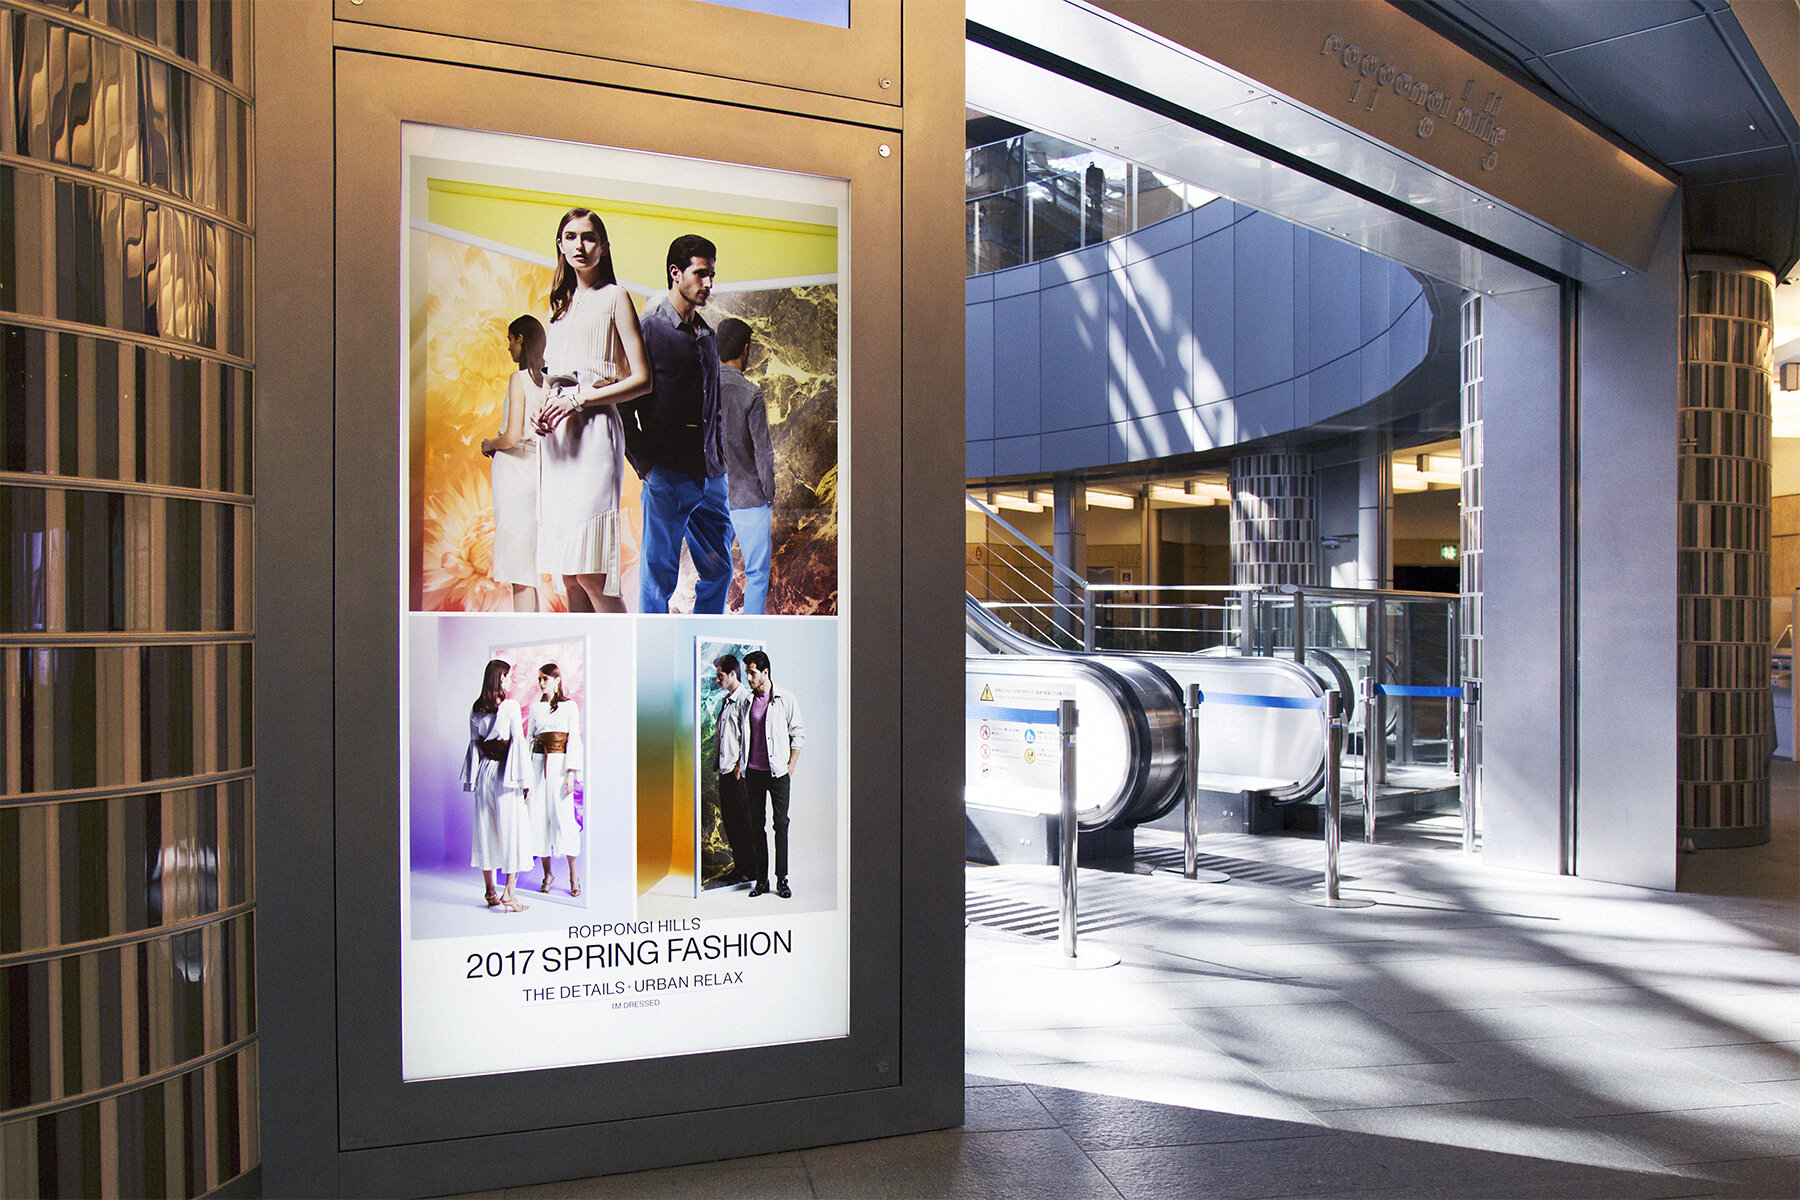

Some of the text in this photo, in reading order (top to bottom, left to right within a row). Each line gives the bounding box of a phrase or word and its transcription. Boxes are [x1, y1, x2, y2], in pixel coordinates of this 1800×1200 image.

[568, 917, 701, 939] ROPPONGI HILLS
[466, 929, 792, 979] 2017 SPRING FASHION
[522, 971, 743, 1002] THE DETAILS URBAN RELAX
[623, 999, 660, 1009] DRESSED
